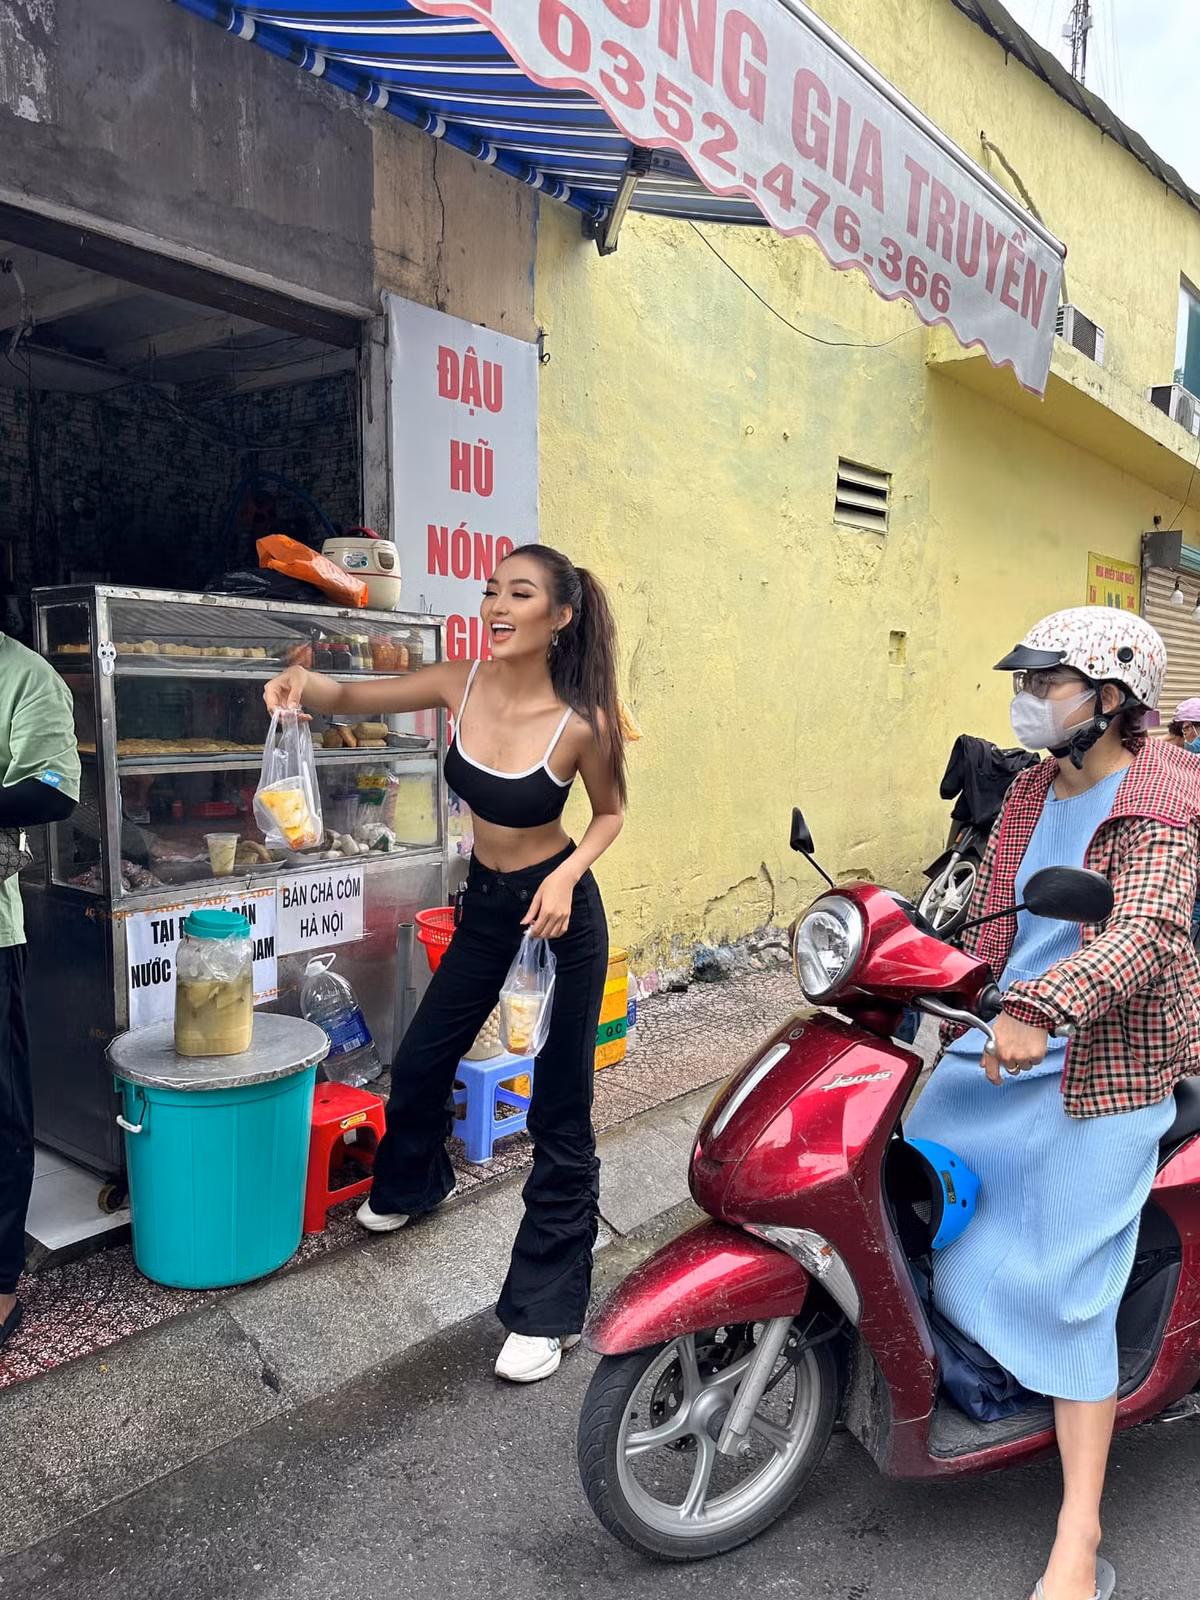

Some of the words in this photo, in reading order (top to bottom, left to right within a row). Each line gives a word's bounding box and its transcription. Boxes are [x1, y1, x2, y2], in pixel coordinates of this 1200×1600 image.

[538, 0, 951, 313] 0352.476.366
[604, 0, 768, 125] NG
[792, 67, 884, 214] GIA
[904, 154, 1047, 330] TRUYỀN
[437, 345, 503, 416] ĐẬU
[450, 438, 494, 498] HŨ
[283, 881, 307, 908] BÁN
[310, 877, 334, 904] CHẢ
[337, 874, 360, 900] CỐM
[151, 918, 174, 947] TẠI
[300, 912, 319, 938] HÀ
[322, 910, 343, 937] NỘI
[131, 957, 171, 989] NƯỚC
[252, 936, 275, 962] AM
